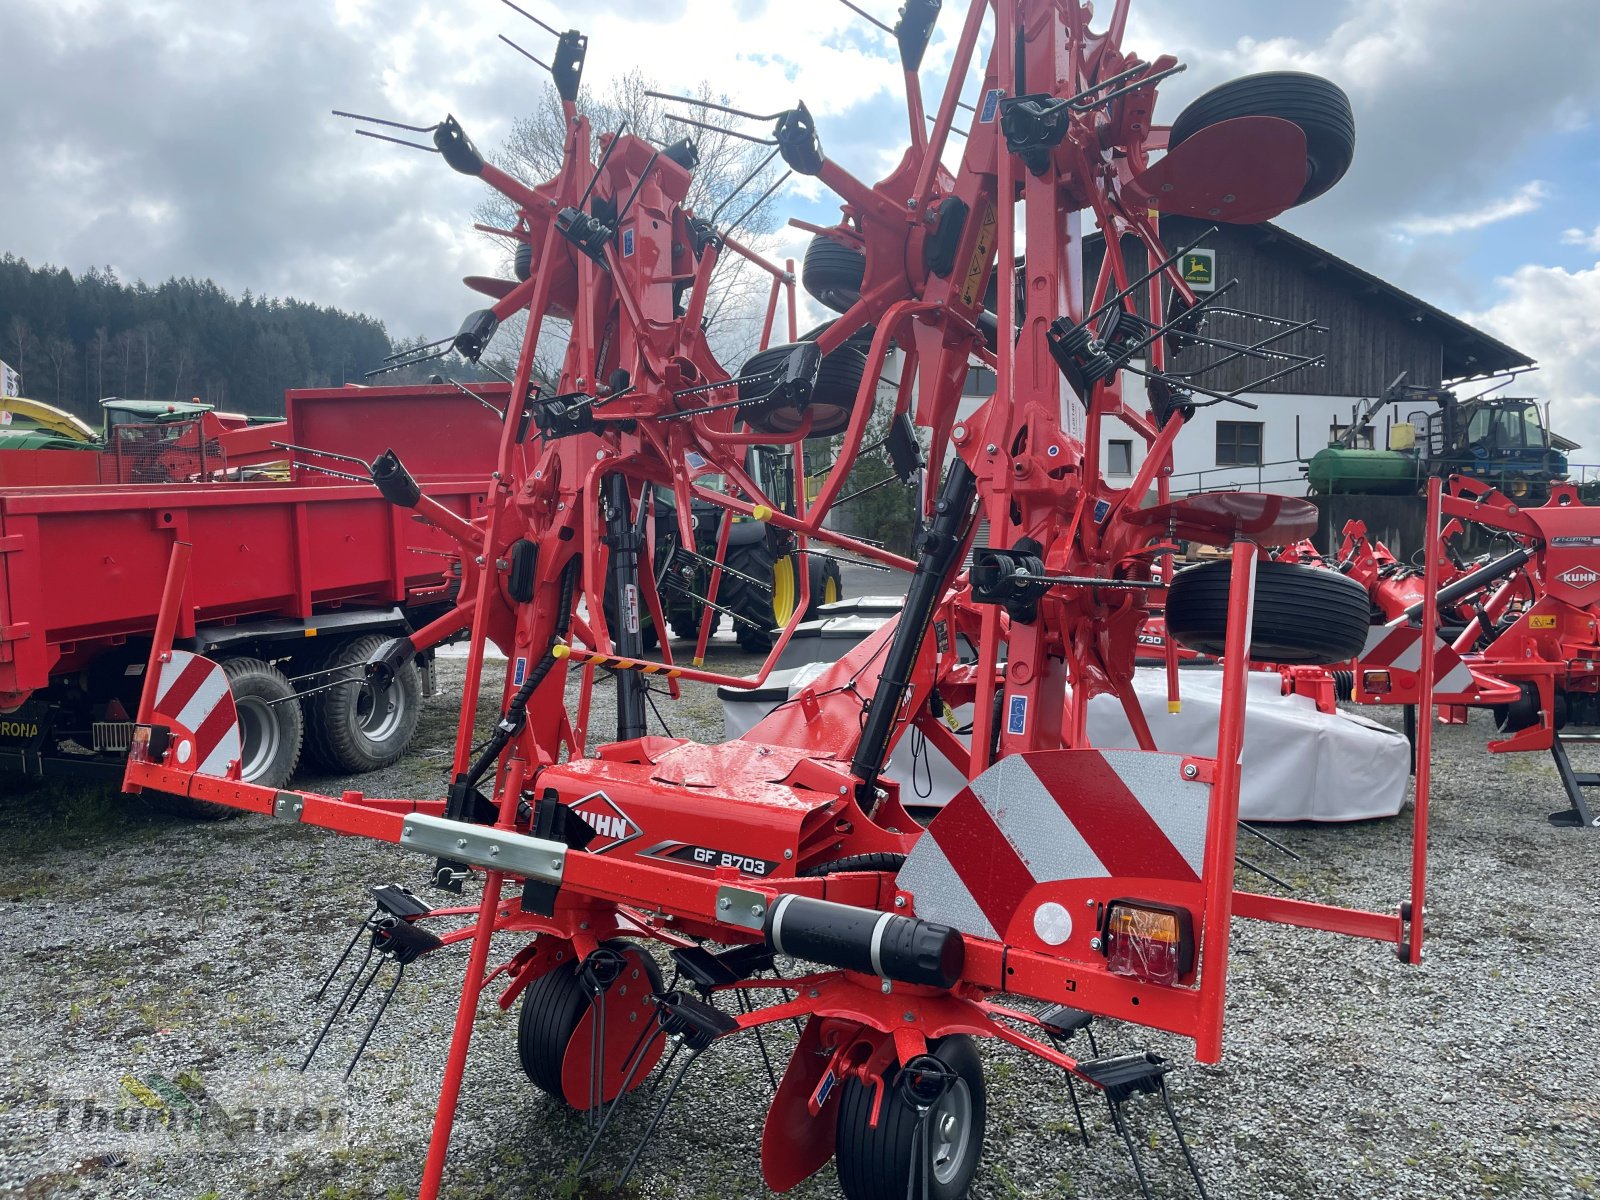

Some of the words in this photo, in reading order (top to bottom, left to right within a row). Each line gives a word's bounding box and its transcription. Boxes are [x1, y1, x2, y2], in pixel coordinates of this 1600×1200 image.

[1563, 573, 1596, 582] KUHN
[0, 721, 39, 738] RONA
[694, 847, 717, 863] GF
[720, 853, 766, 875] 8703
